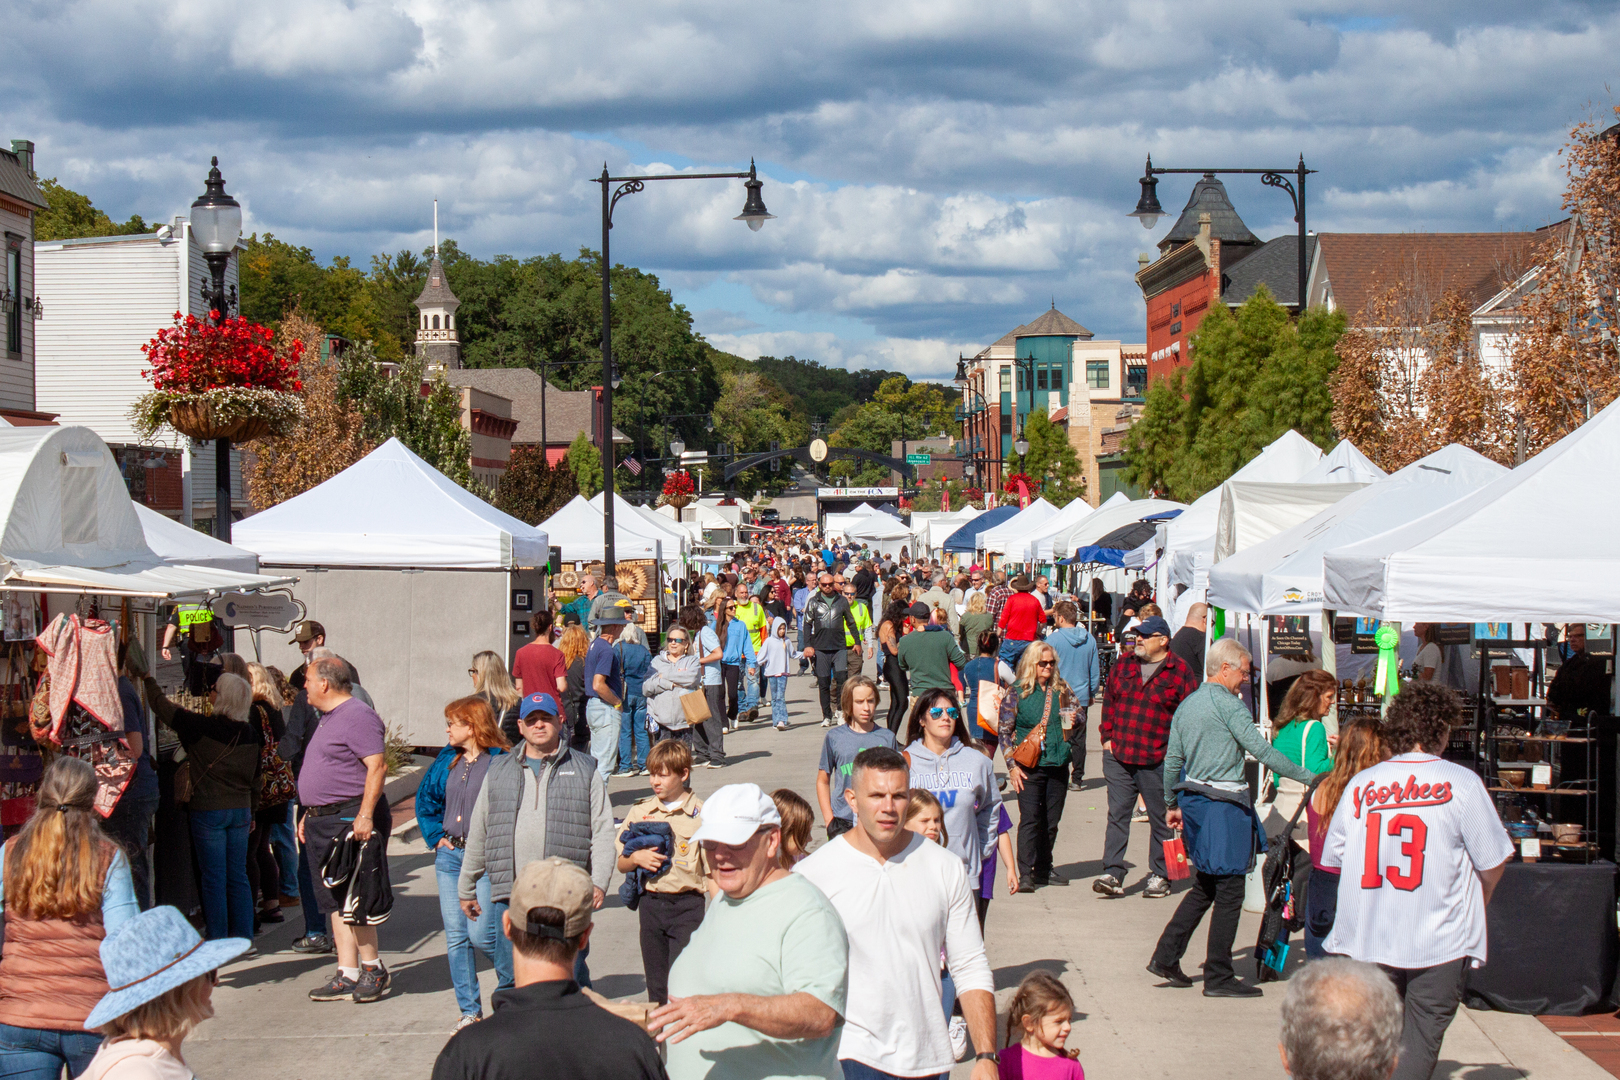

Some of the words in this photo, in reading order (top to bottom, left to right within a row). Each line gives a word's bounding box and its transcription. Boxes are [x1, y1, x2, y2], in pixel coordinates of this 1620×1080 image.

[186, 612, 208, 622] POLICE
[1353, 774, 1453, 819] Voorhees
[1361, 813, 1428, 892] 13
